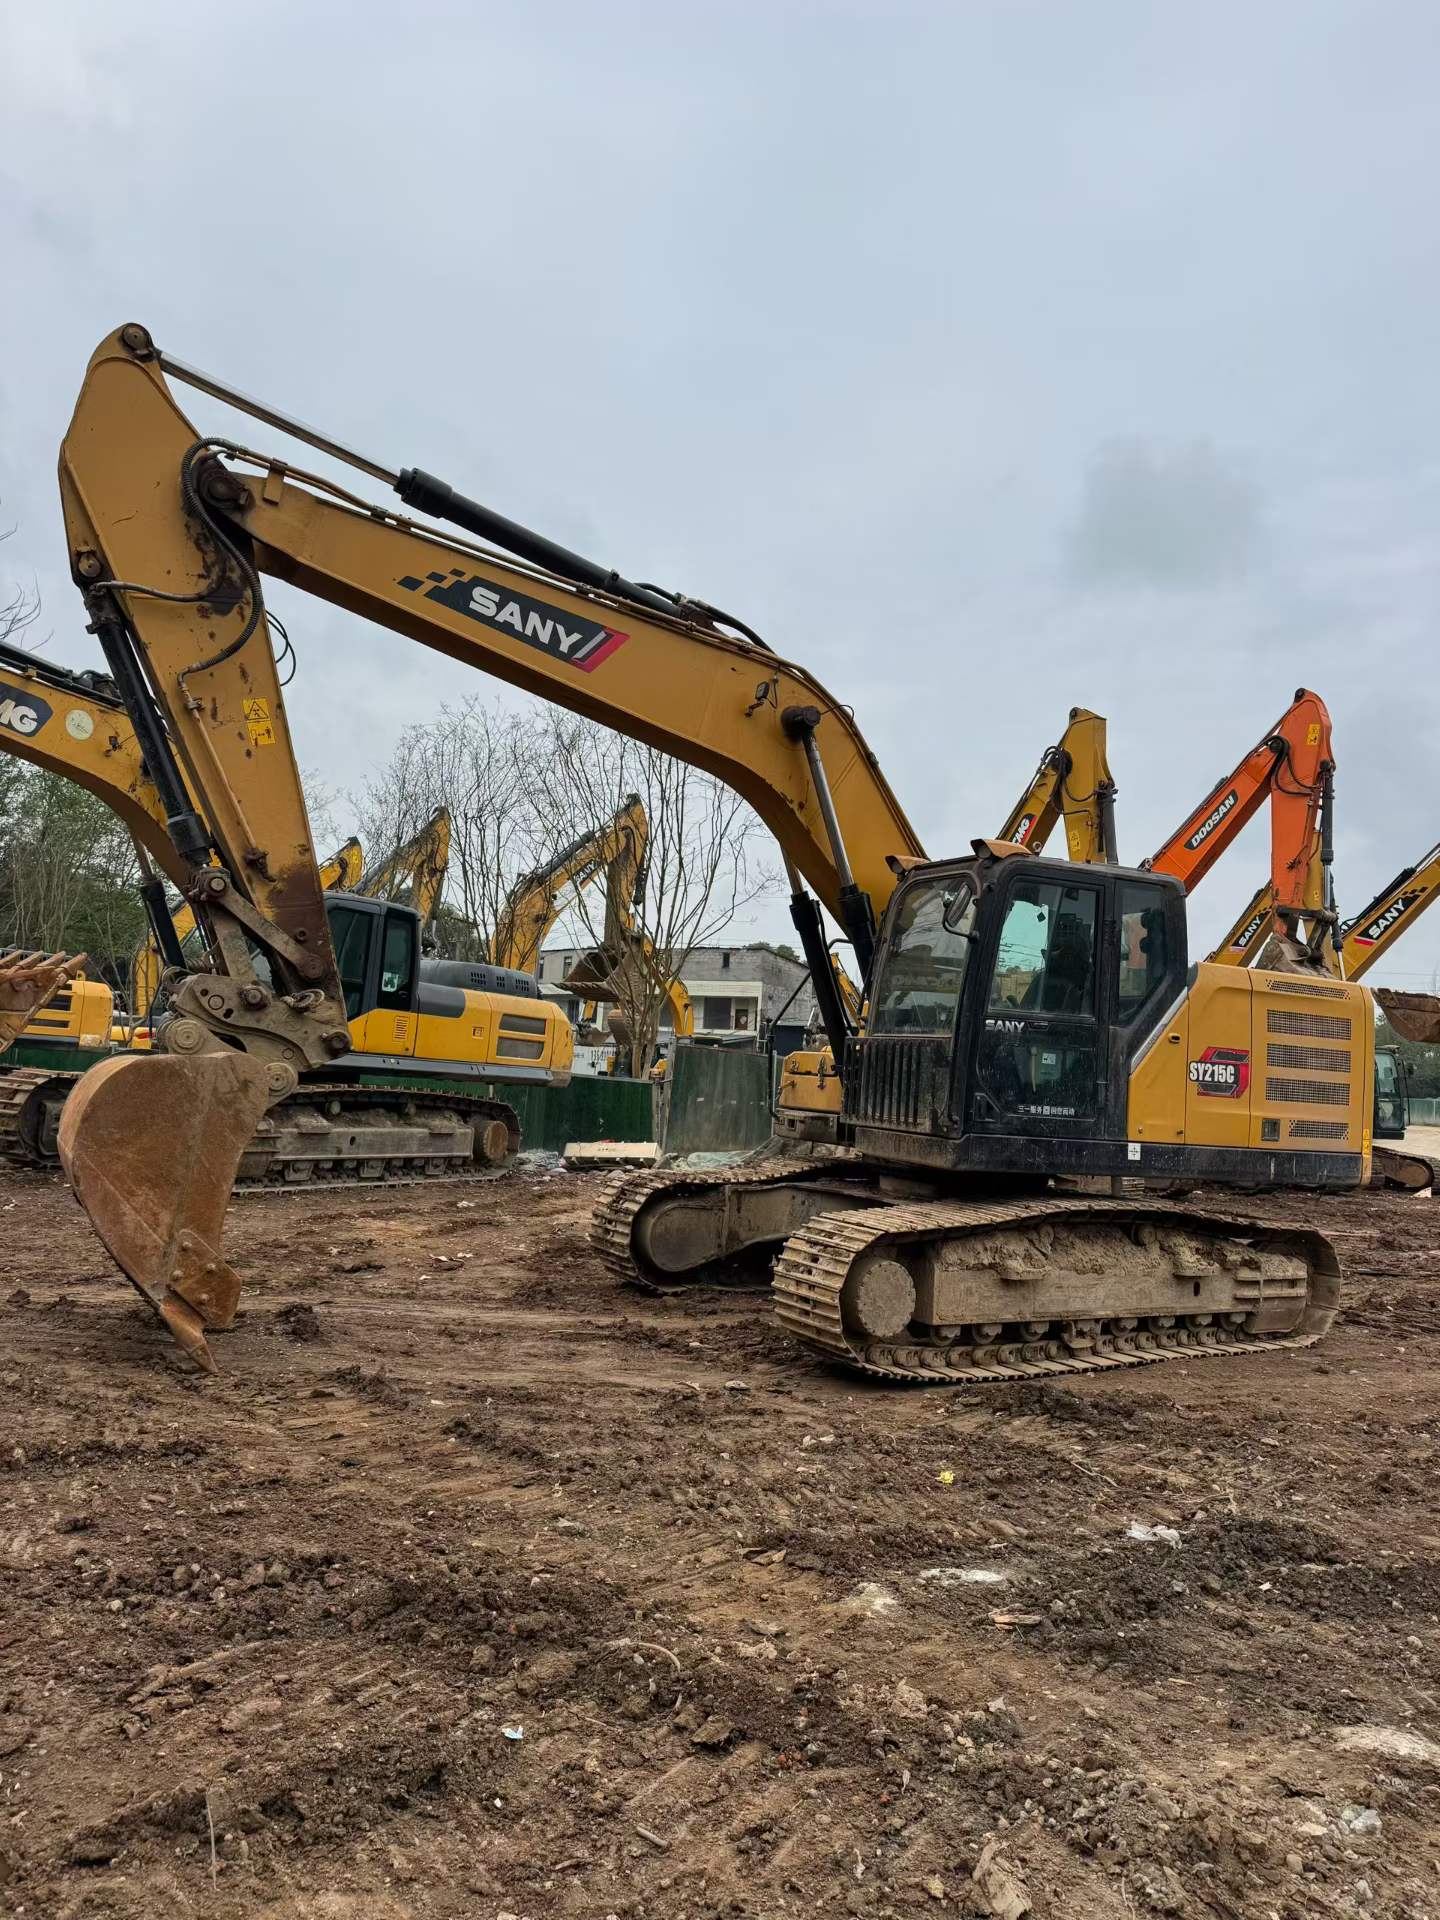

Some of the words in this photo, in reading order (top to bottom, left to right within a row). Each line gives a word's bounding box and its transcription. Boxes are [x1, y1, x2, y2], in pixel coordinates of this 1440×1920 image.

[469, 586, 583, 654] SANY
[1191, 794, 1235, 847] DOOSAN
[1238, 915, 1261, 947] SANY
[1368, 898, 1405, 939] SANY
[985, 1019, 1026, 1033] SANY
[1190, 1062, 1235, 1083] SY215C
